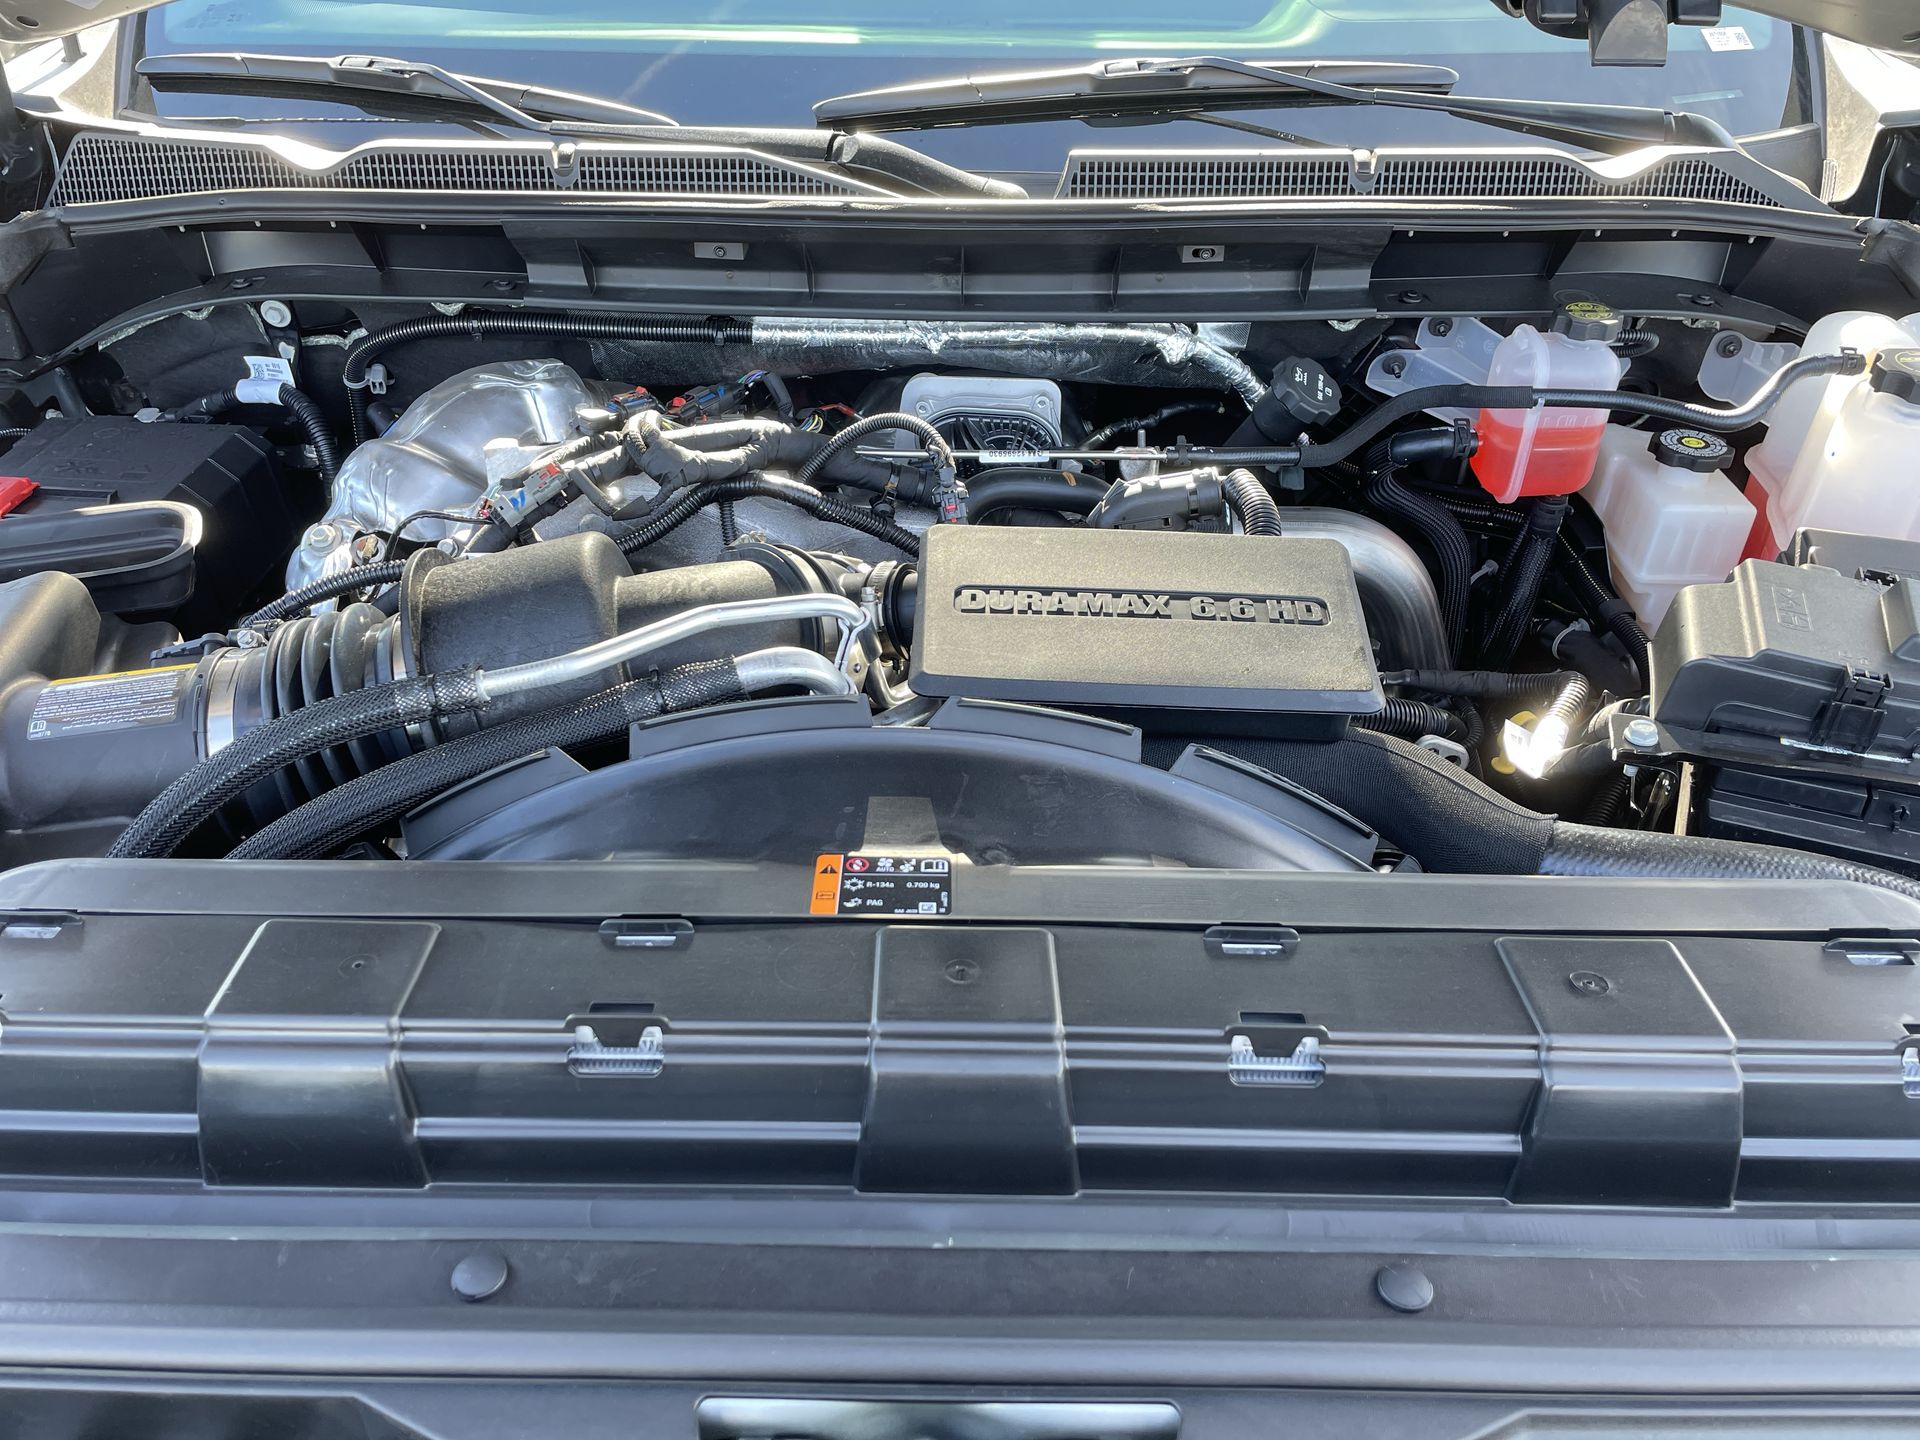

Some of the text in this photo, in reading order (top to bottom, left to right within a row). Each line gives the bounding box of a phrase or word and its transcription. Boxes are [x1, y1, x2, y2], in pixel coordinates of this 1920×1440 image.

[960, 588, 1324, 624] DURAMAX 6.6 HD
[929, 881, 940, 890] kg
